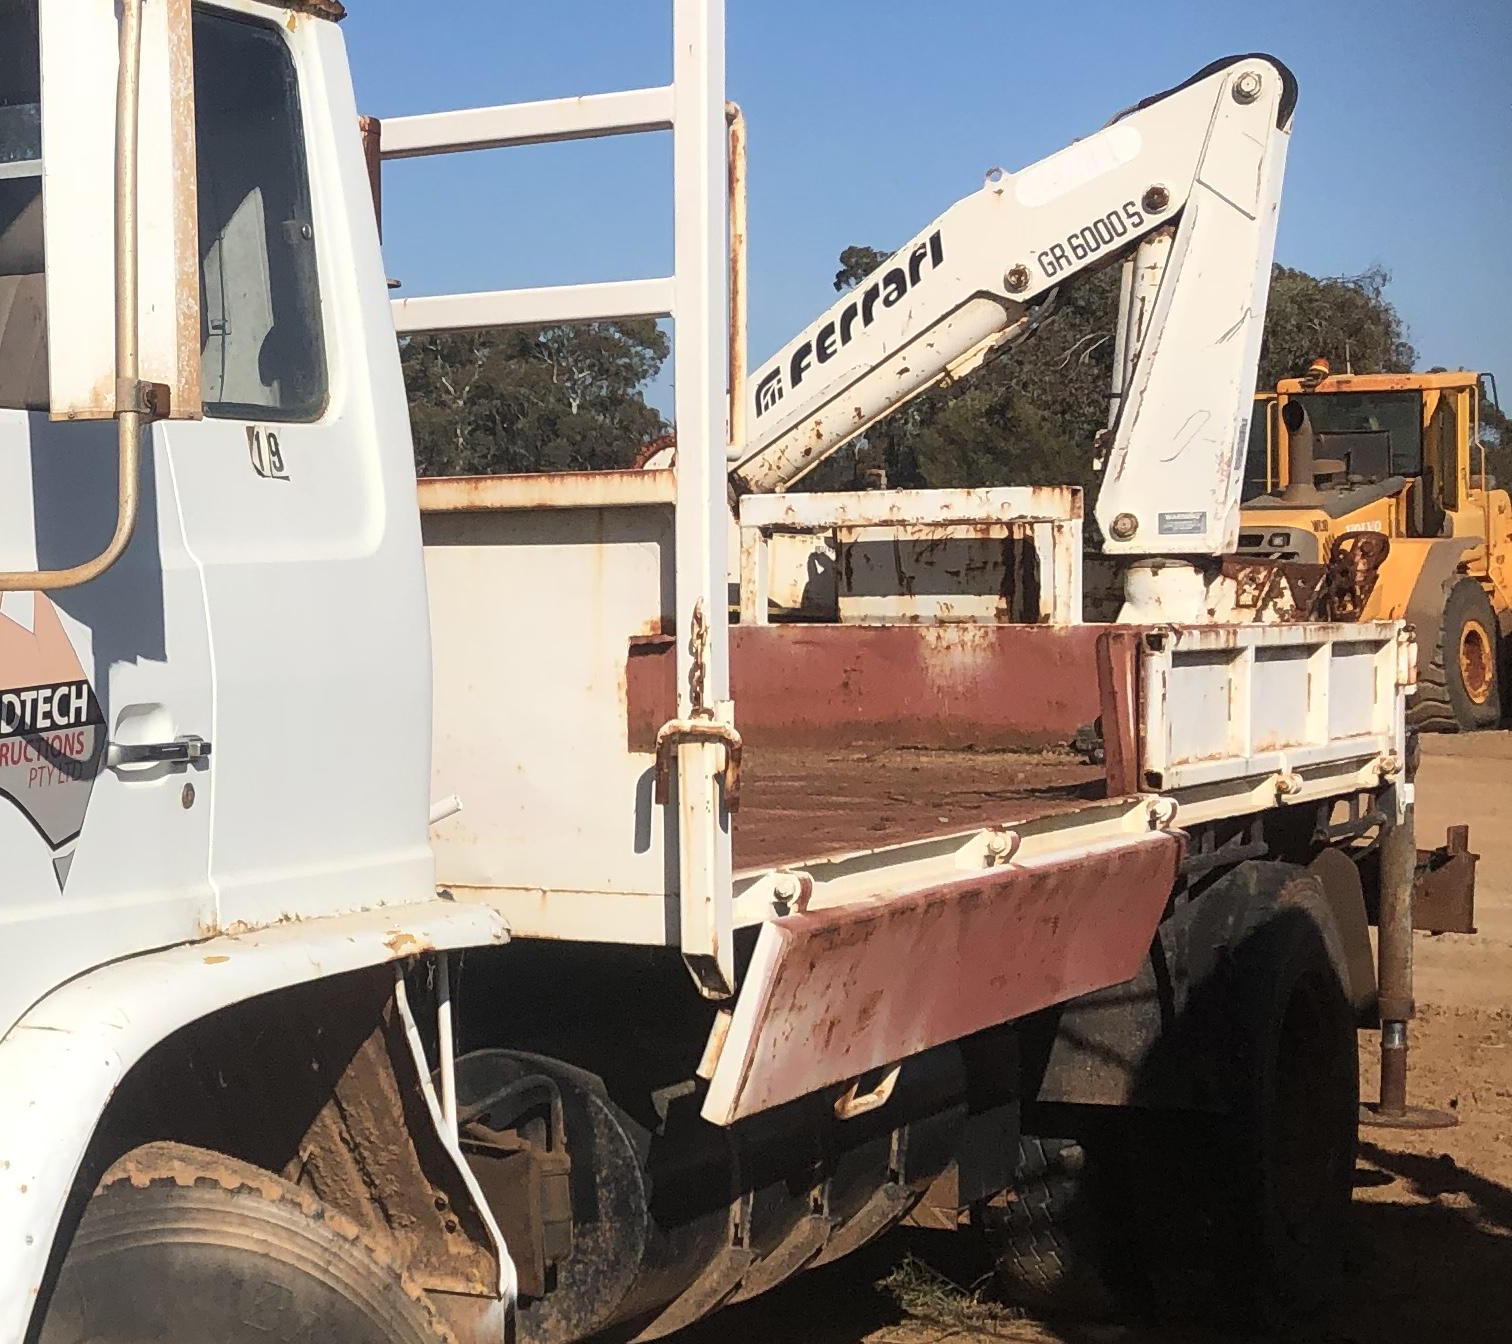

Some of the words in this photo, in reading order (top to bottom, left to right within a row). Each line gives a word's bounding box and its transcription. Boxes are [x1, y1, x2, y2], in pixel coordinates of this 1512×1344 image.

[1068, 207, 1128, 262] 6000
[254, 430, 285, 473] 19
[28, 764, 55, 789] PTY
[58, 760, 83, 784] LTD
